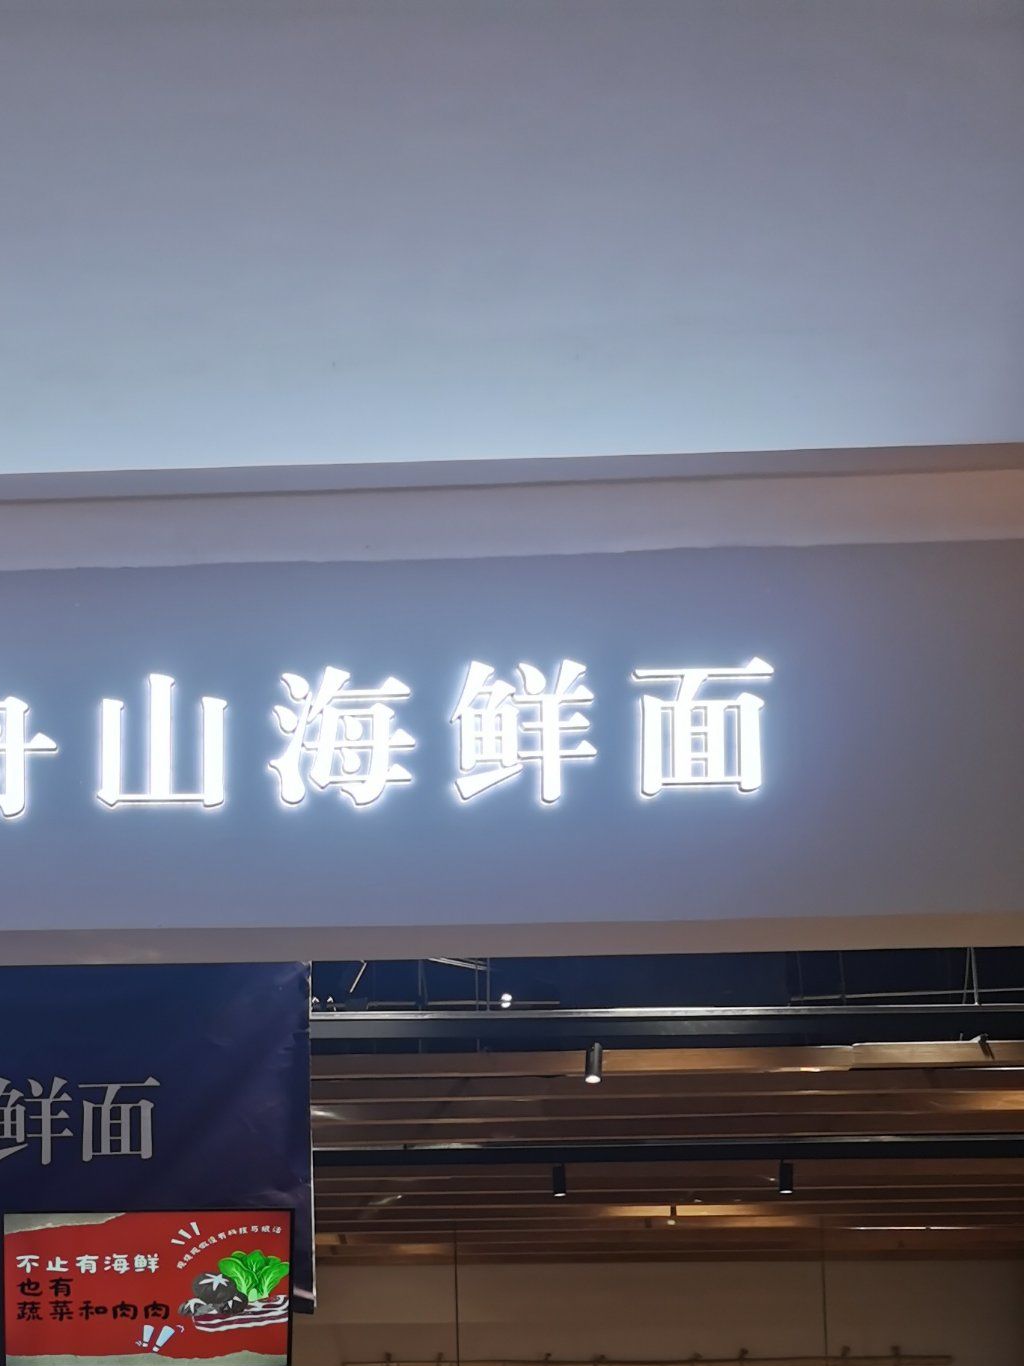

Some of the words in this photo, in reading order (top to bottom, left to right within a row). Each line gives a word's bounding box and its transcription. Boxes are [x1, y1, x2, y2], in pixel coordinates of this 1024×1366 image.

[16, 1253, 160, 1275] 不止有海鲜
[17, 1277, 74, 1298] 也有
[16, 1300, 170, 1322] 蔬菜和肉肉
